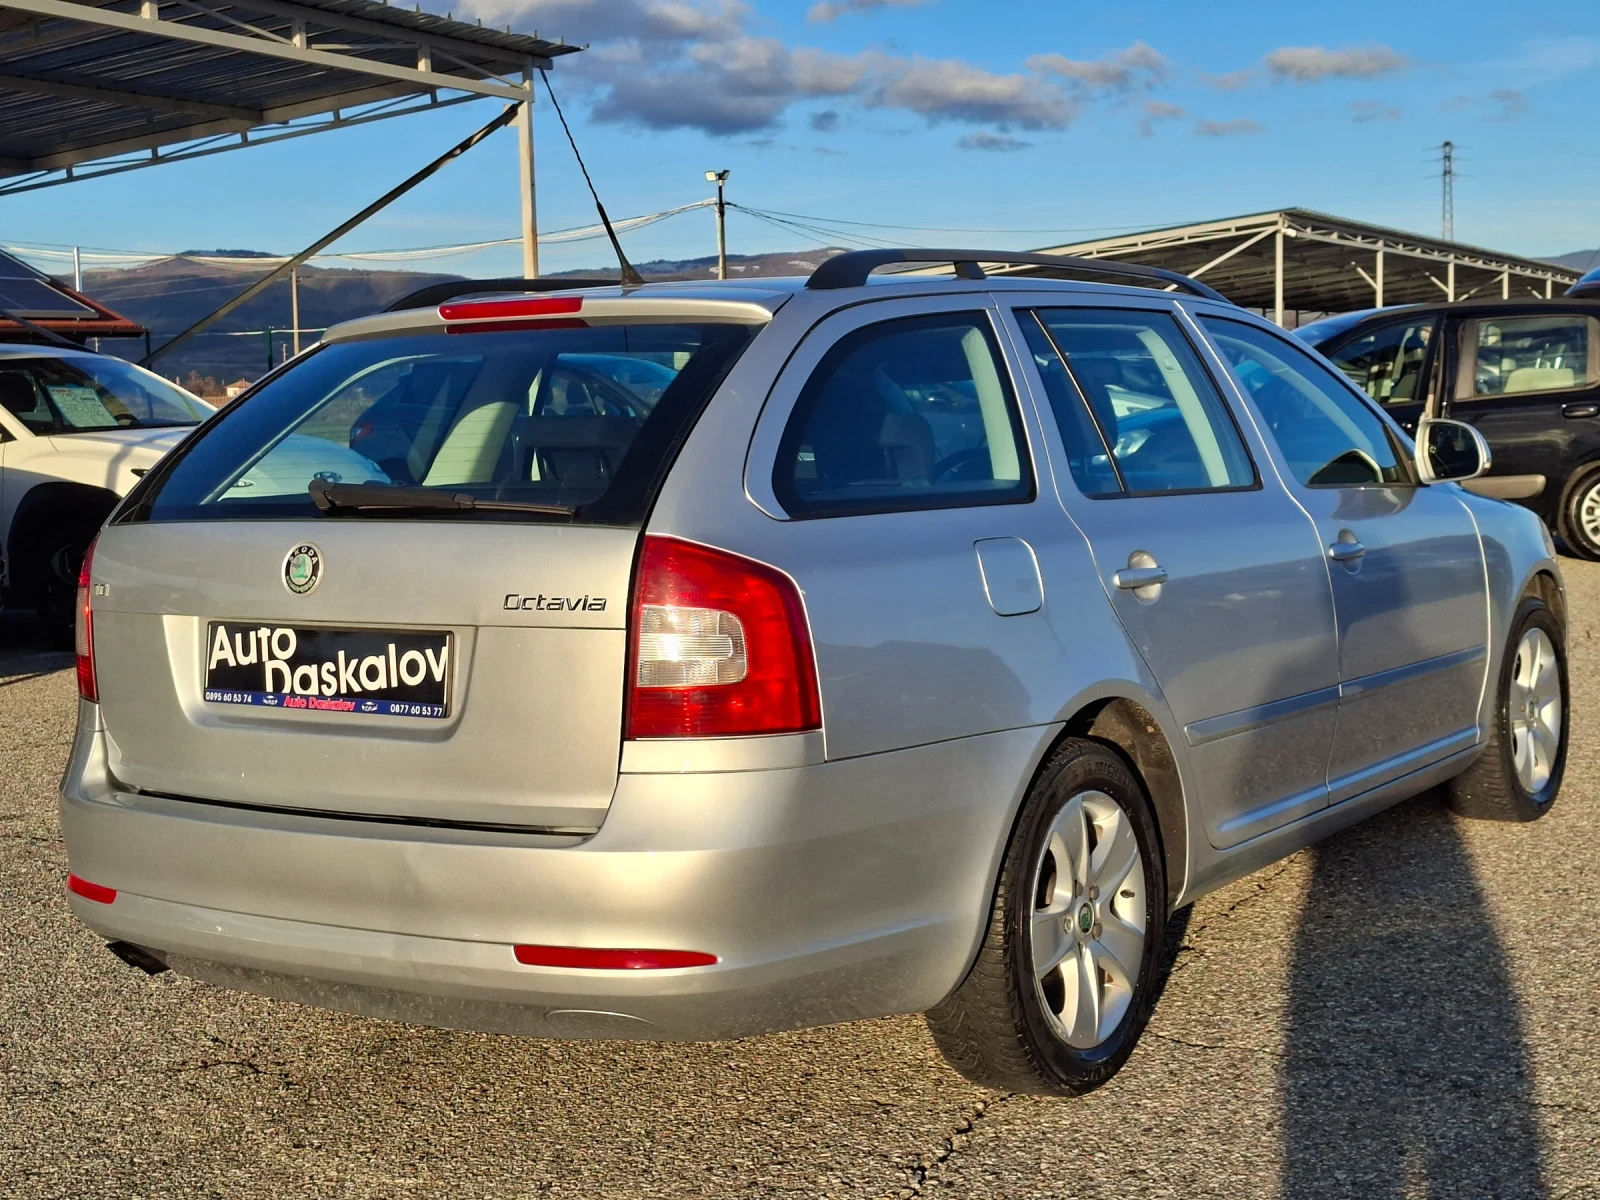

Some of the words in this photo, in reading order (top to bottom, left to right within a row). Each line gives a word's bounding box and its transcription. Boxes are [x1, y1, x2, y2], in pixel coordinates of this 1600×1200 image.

[503, 593, 607, 611] Octavia
[209, 625, 297, 670] Auto
[264, 643, 448, 697] Daskalov
[205, 691, 222, 701] 0895
[223, 693, 232, 702] 60
[233, 693, 242, 703] 53
[243, 694, 252, 703] 74
[283, 695, 308, 709] Auto
[308, 697, 356, 712] Daskalov
[390, 703, 409, 714] 0877
[410, 705, 421, 715] 60
[421, 706, 432, 716] 53
[433, 707, 443, 717] 77
